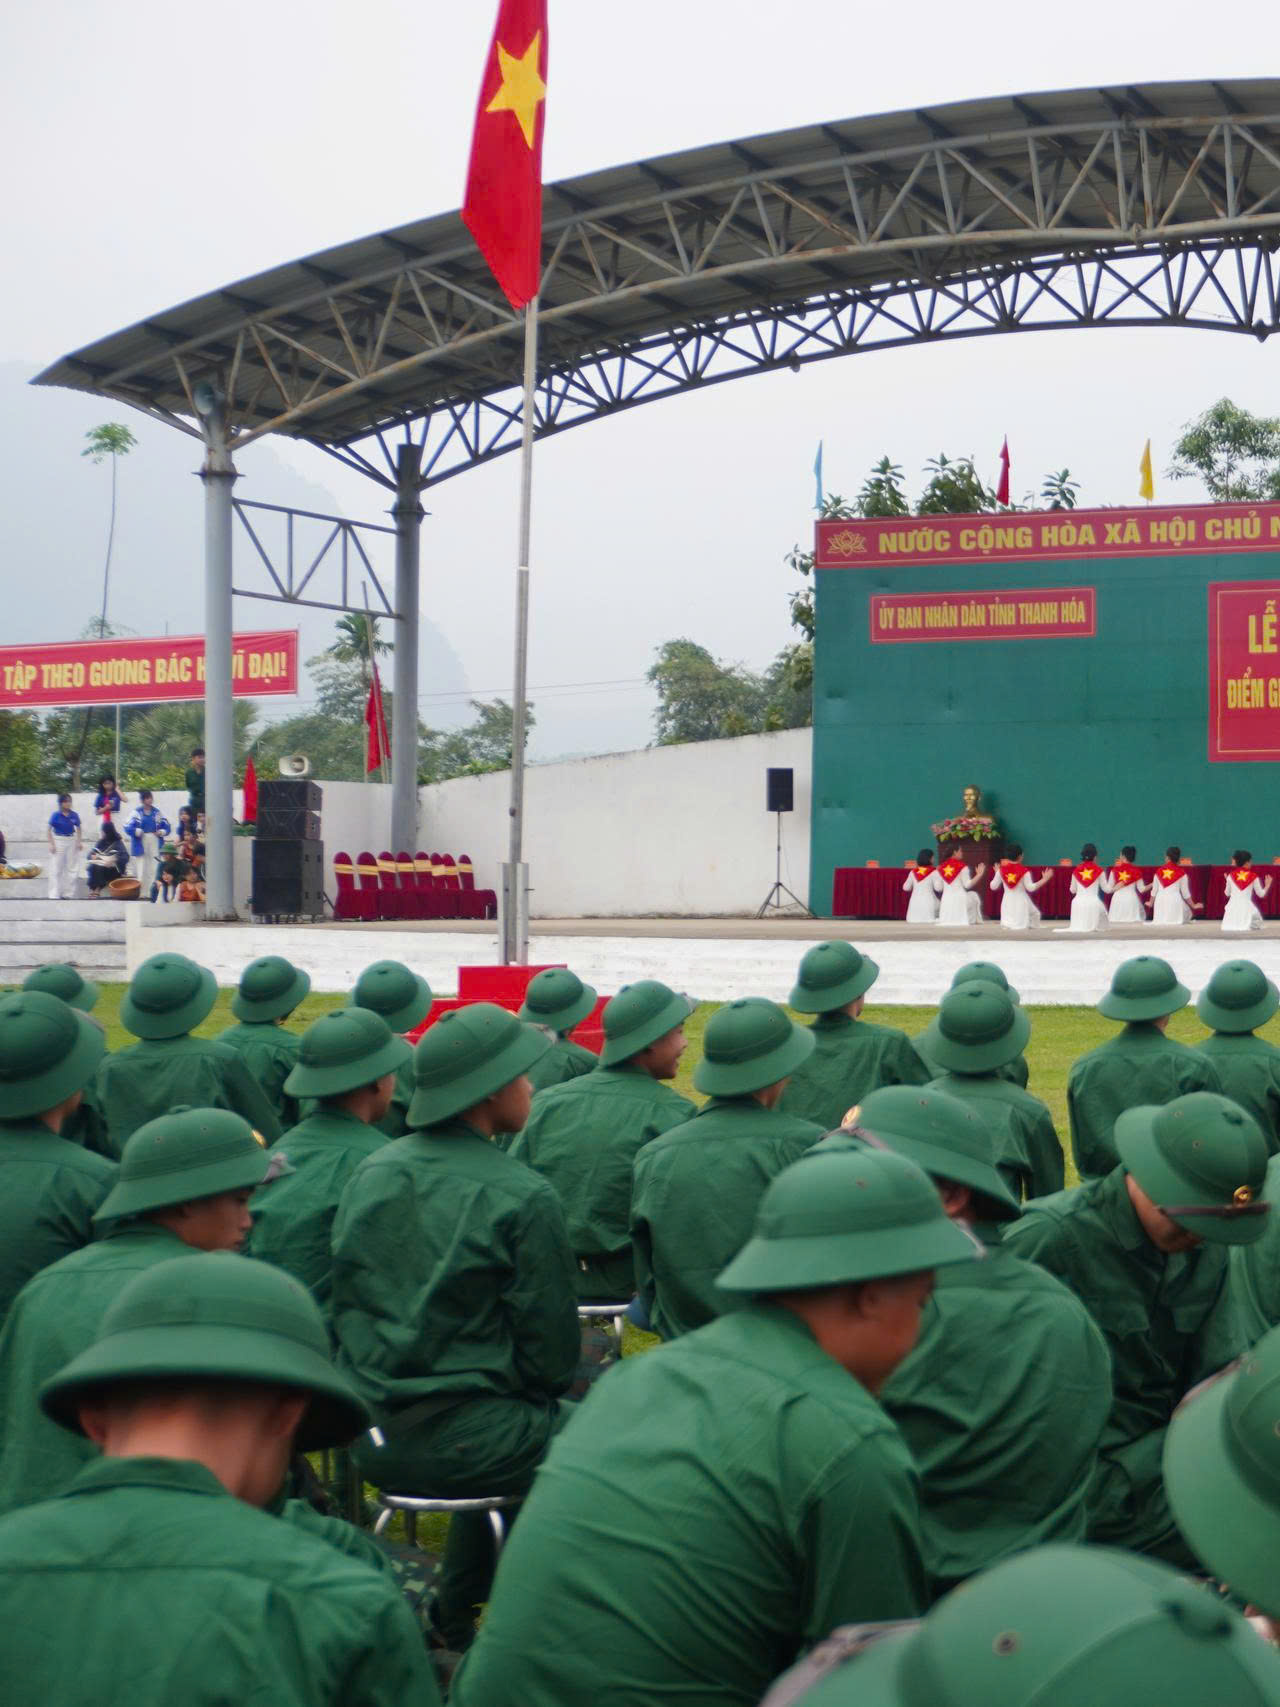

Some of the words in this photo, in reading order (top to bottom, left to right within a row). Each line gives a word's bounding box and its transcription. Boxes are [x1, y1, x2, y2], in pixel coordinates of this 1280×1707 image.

[879, 527, 951, 553] NƯỚC
[959, 524, 1032, 554] CỘNG
[1041, 520, 1096, 547] HÒA
[1103, 518, 1141, 545] XÃ
[1150, 516, 1195, 546] HỘI
[1205, 511, 1261, 540] CHỦ
[879, 600, 894, 629] ỦY
[897, 606, 922, 629] BAN
[924, 601, 958, 628] NHÂN
[961, 600, 986, 627] DÂN
[988, 597, 1016, 626] TỈNH
[1018, 601, 1058, 625] THANH
[1061, 596, 1086, 623] HÓA
[1248, 599, 1278, 653] LỄ
[3, 660, 37, 695] TẬP
[40, 663, 84, 689] THEO
[89, 658, 150, 686] GƯƠNG
[155, 653, 192, 683] BÁC
[196, 656, 206, 681] H
[249, 651, 287, 684] ĐẠI!
[1227, 666, 1265, 709] ĐIỂM
